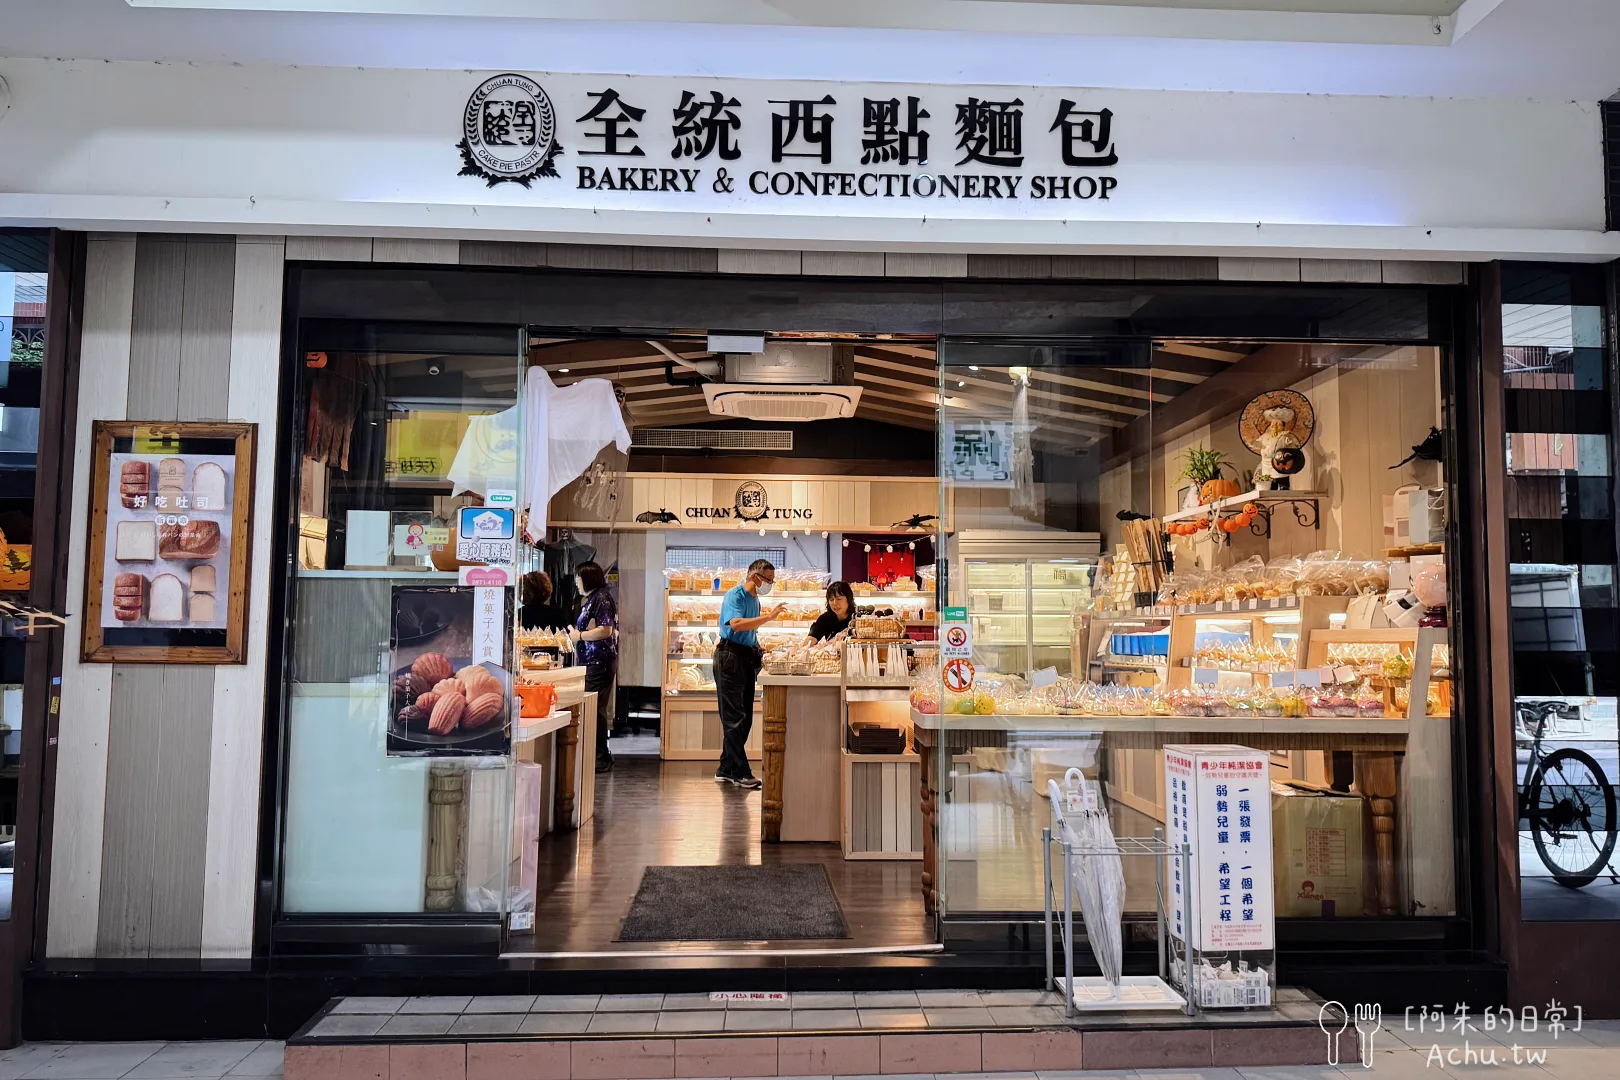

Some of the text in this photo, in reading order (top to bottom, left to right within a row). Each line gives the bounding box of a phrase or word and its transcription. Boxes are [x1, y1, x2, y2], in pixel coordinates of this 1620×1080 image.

[486, 78, 533, 91] CHUAN TUNG
[575, 87, 1119, 167] 全統西點麵包
[478, 149, 499, 168] CAKE
[499, 162, 514, 170] PIE
[576, 165, 1118, 200] BAKERY & CONFECTIONERY SHOP
[133, 495, 209, 508] 好吃吐司
[685, 507, 813, 519] CHUAN TUNG
[482, 588, 496, 658] 燒菓子大賞
[1201, 760, 1263, 770] 青少年純潔協會
